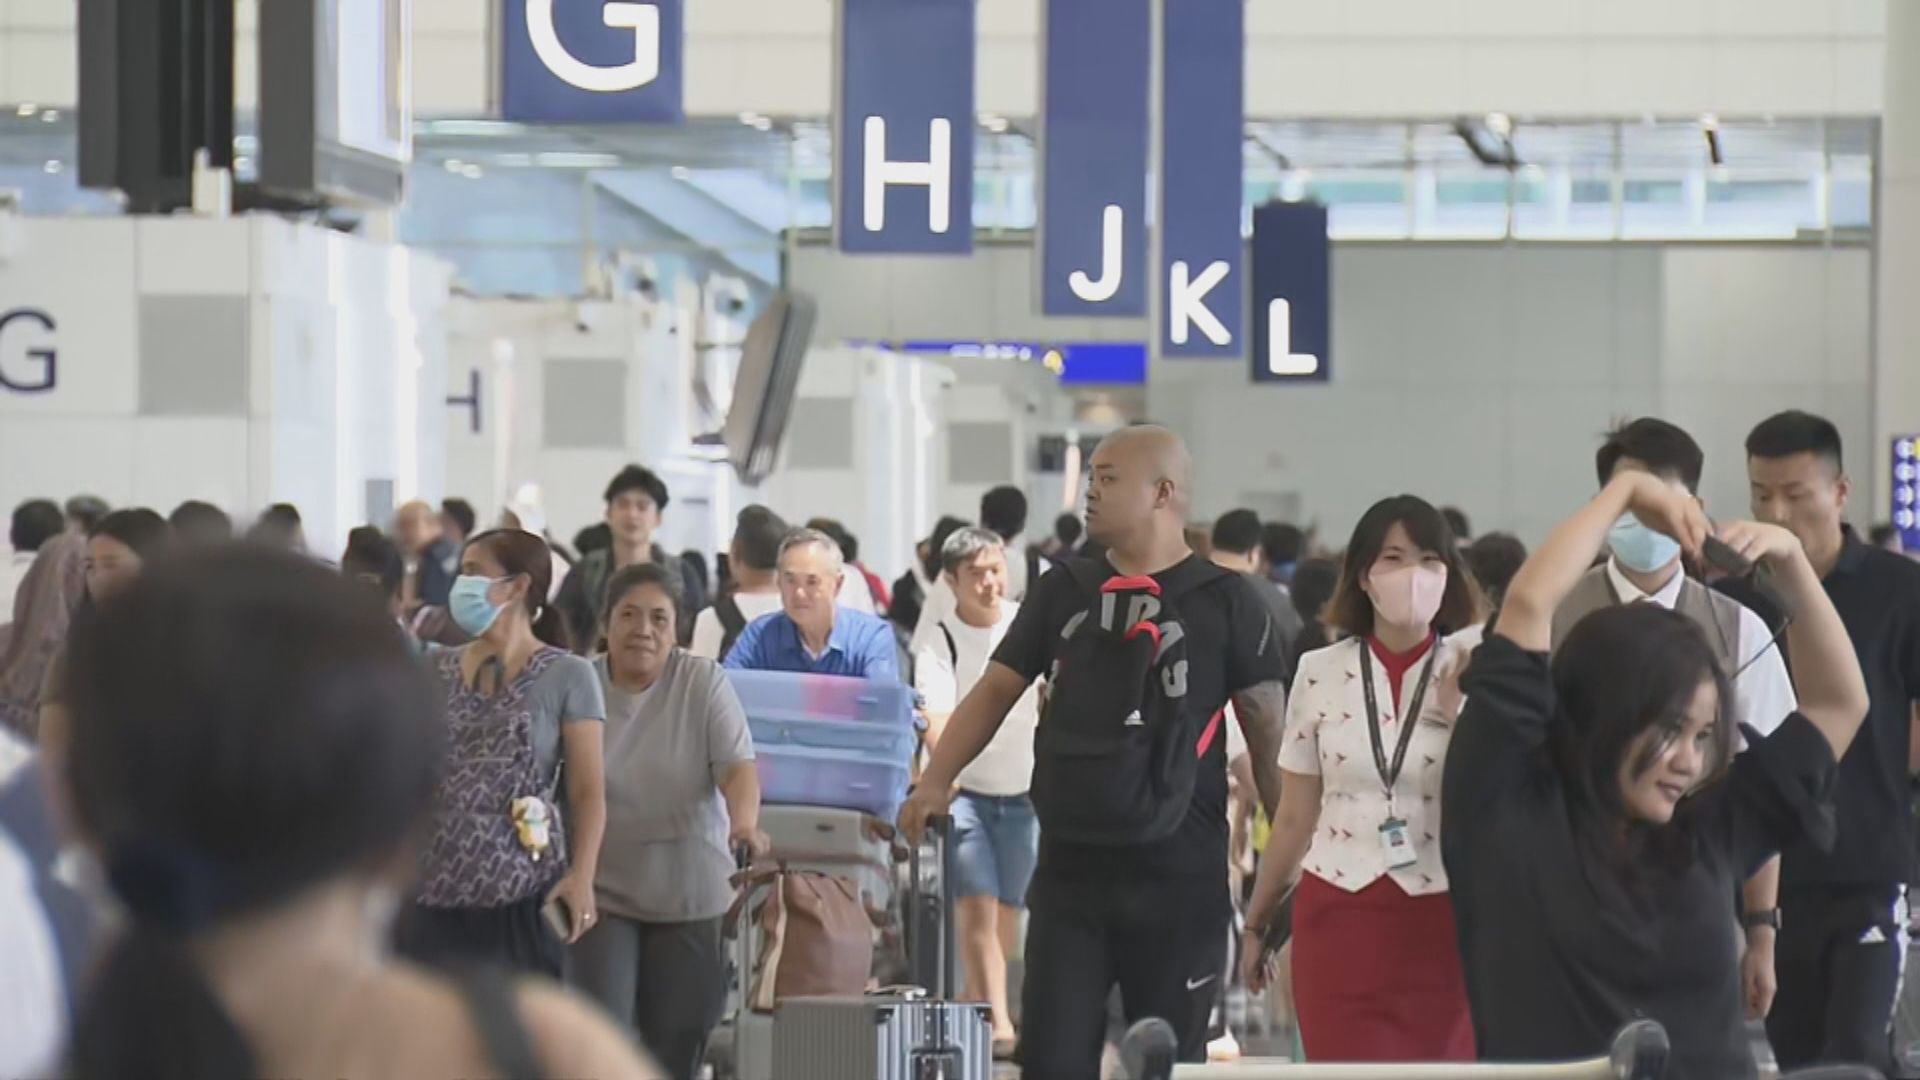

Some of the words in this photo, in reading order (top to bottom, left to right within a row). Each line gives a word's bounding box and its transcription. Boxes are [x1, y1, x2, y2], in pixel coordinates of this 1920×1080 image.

[525, 0, 660, 92] G
[863, 115, 951, 233] H
[1068, 204, 1123, 302] J
[1169, 260, 1232, 346] K
[1269, 297, 1319, 375] L
[0, 308, 58, 394] G
